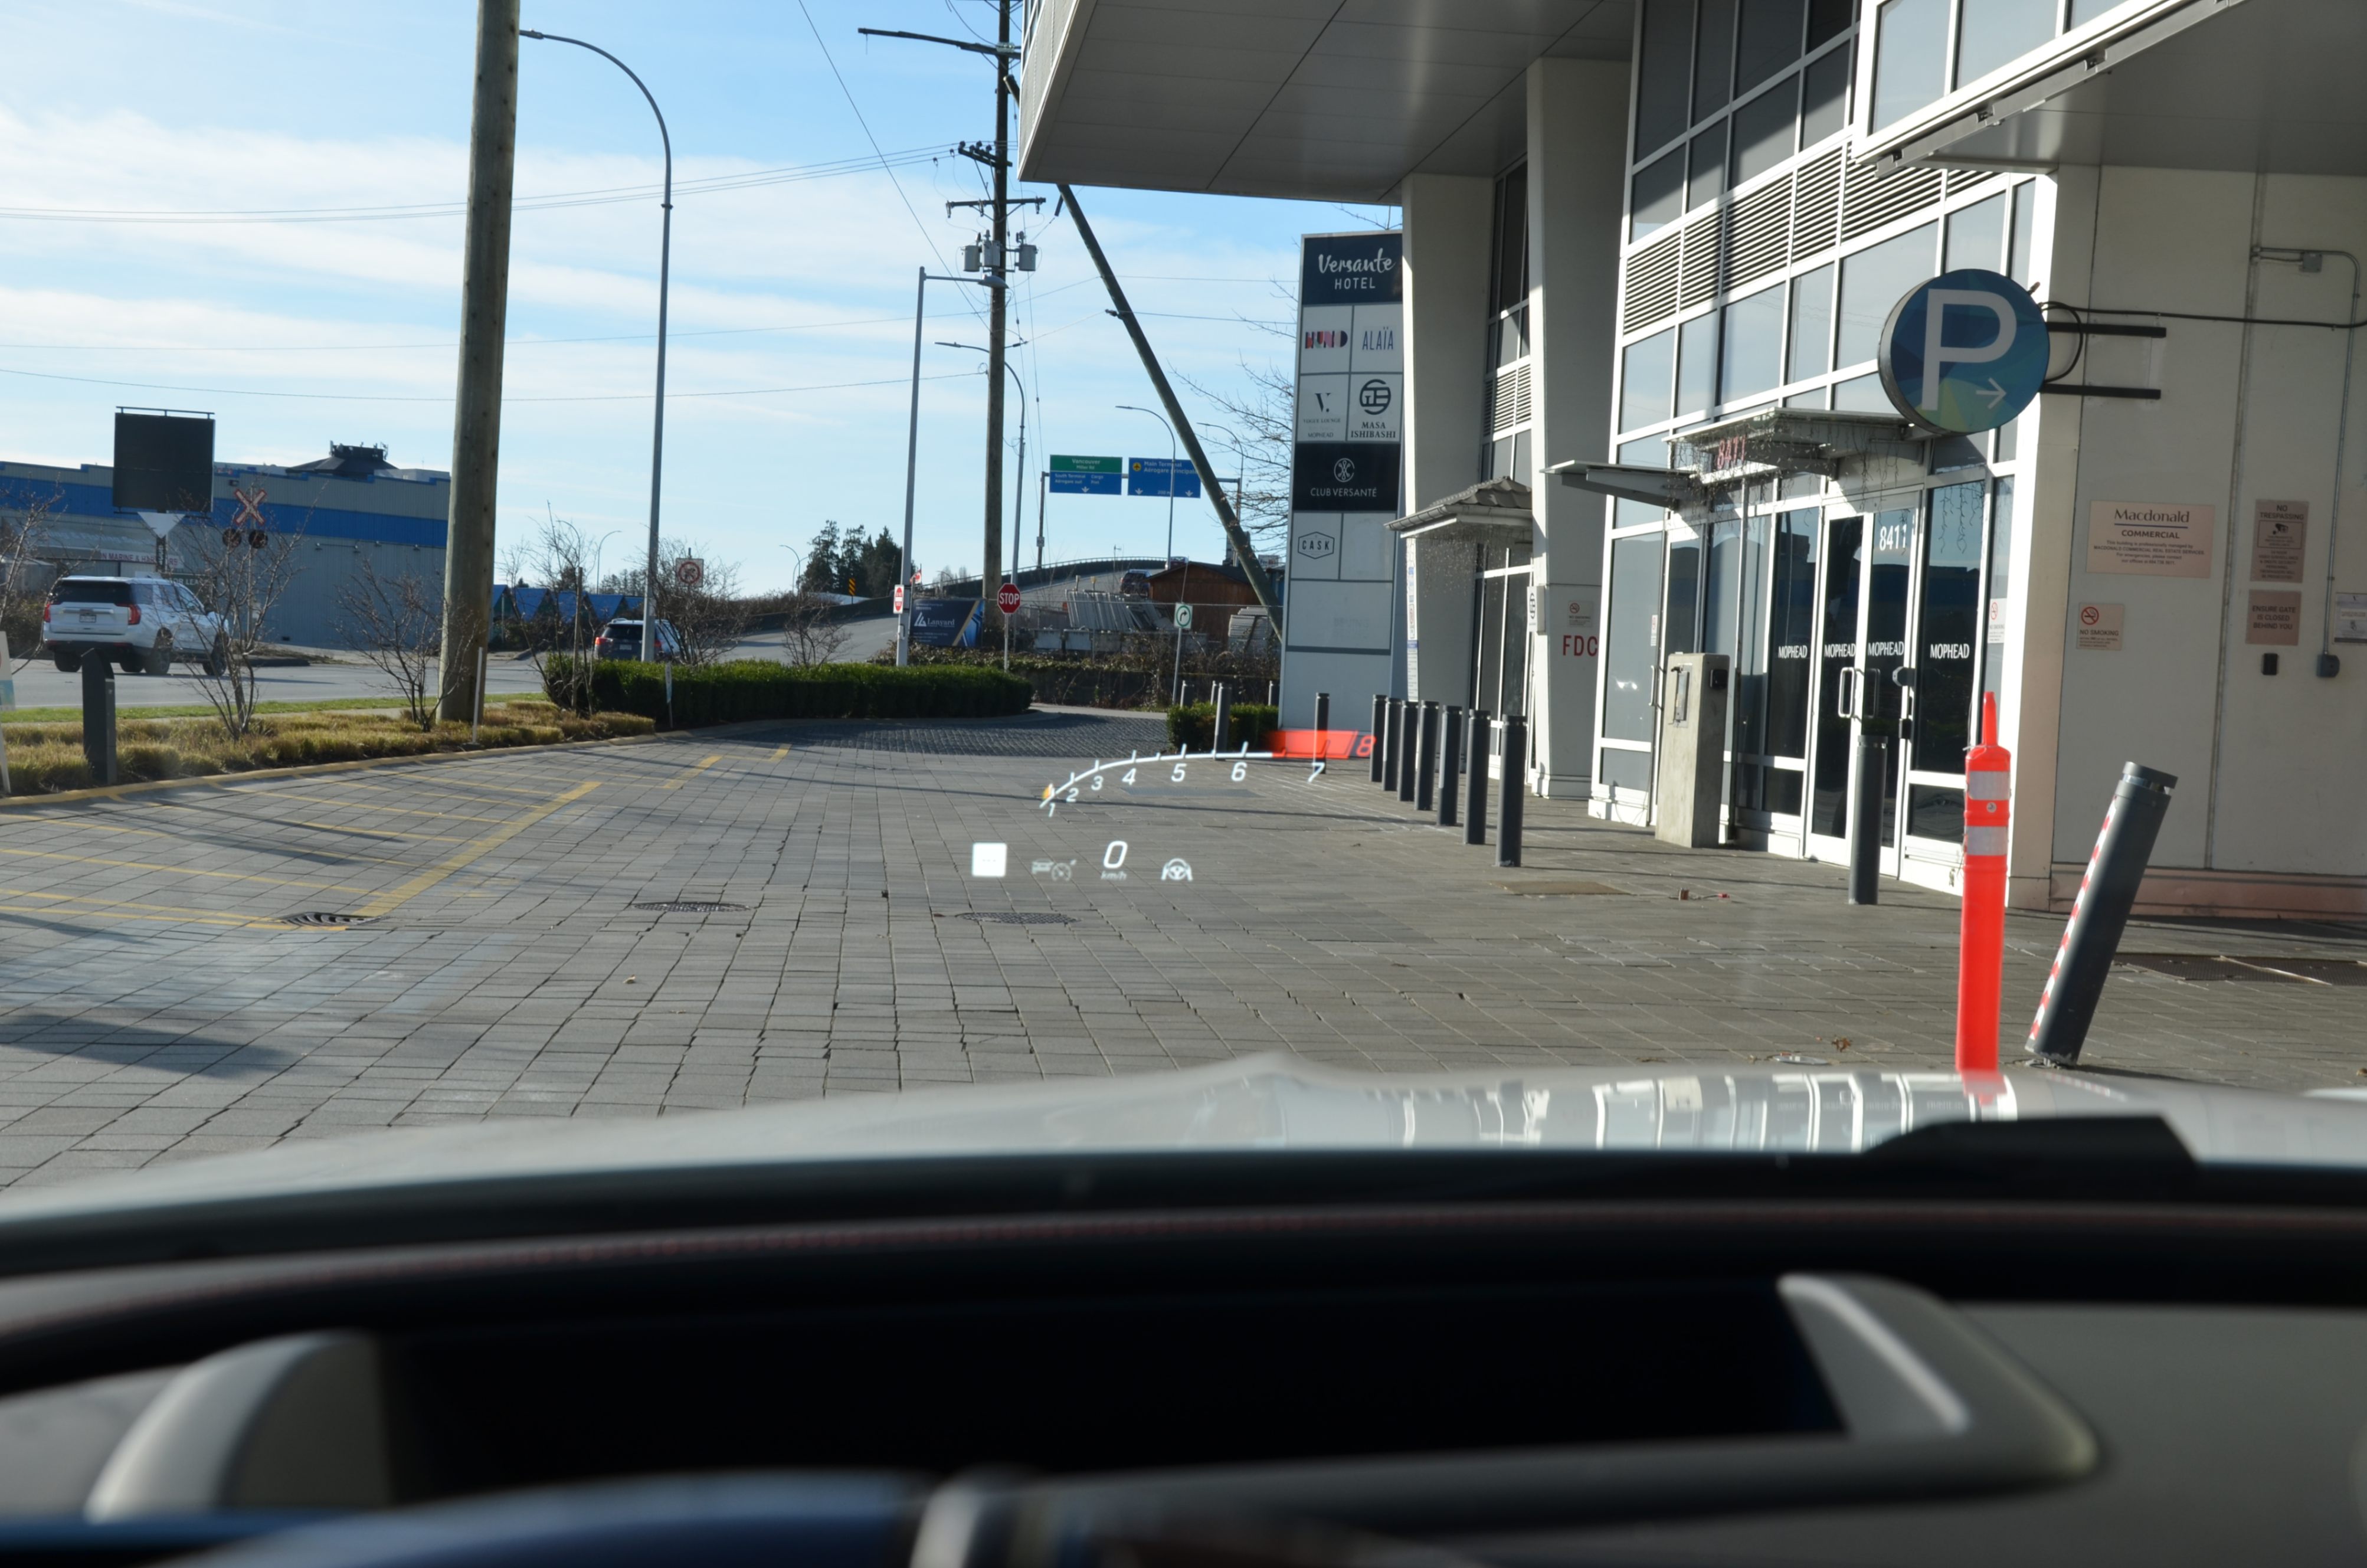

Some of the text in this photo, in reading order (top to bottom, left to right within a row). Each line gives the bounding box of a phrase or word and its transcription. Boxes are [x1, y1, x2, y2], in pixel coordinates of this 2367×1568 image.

[1318, 247, 1396, 274] Versante
[1334, 277, 1376, 290] HOTEL
[1362, 326, 1394, 350] ALAÏA
[1921, 288, 2017, 411] P
[1351, 430, 1396, 438] ISHIBASHI
[1717, 435, 1747, 470] 8411
[1310, 487, 1331, 496] CLUB
[2114, 508, 2190, 523] Macdonald
[2260, 512, 2304, 520] TRESPASSING
[1879, 524, 1907, 552] 8411
[2121, 529, 2180, 539] COMMERCIAL
[1302, 540, 1330, 550] CASK
[108, 552, 134, 561] MARINE
[999, 592, 1020, 605] STOP
[927, 618, 955, 627] Lanyard
[1562, 634, 1599, 657] FDC
[1778, 645, 1808, 659] MOPHEAD
[1824, 643, 1857, 657] MOPHEAD
[1868, 641, 1904, 657] MOPHEAD
[1930, 643, 1970, 659] MOPHEAD
[1048, 734, 1377, 817] 1 2 3 4 5 6 7 8
[1103, 840, 1128, 869] 0
[1101, 870, 1127, 880] km/h
